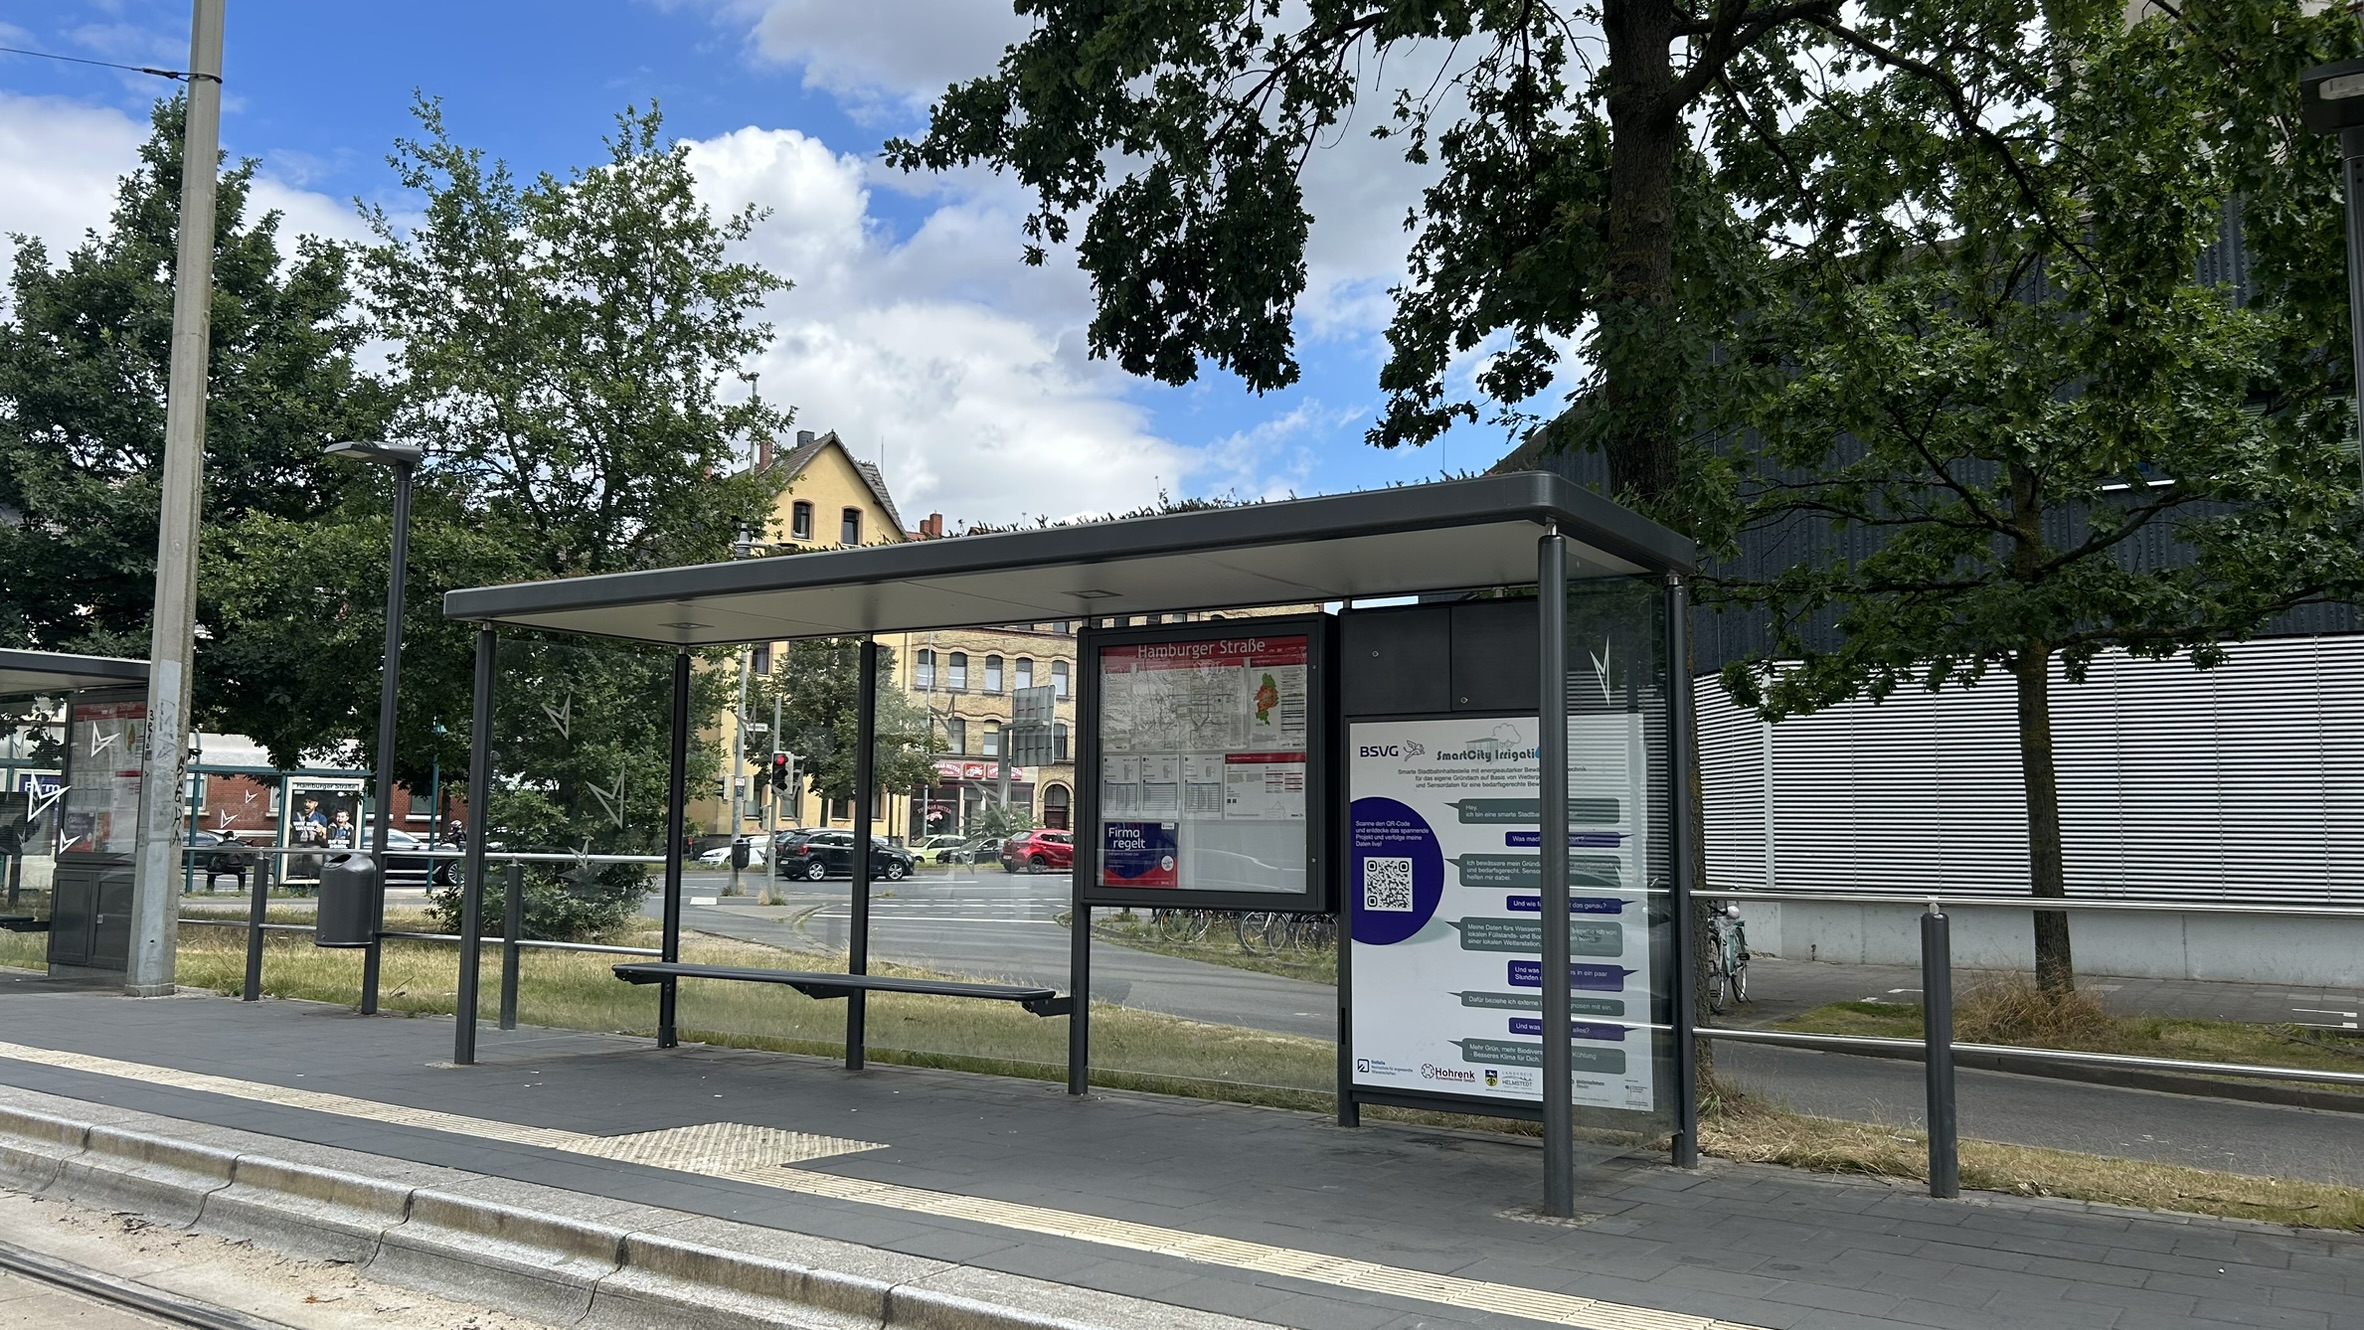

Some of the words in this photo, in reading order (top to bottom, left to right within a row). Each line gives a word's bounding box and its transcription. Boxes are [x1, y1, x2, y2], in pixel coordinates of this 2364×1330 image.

[1138, 643, 1215, 658] Hamburger
[1220, 638, 1266, 654] Straße
[1360, 746, 1399, 757] BSVG
[1437, 750, 1491, 762] SmartCity
[1108, 826, 1140, 838] Firma
[1113, 838, 1146, 850] regelt
[1485, 1044, 1500, 1052] Grün,
[1572, 1051, 1596, 1060] Kühlung
[1526, 1054, 1540, 1062] Dich.
[1435, 1067, 1475, 1079] Hohrenk
